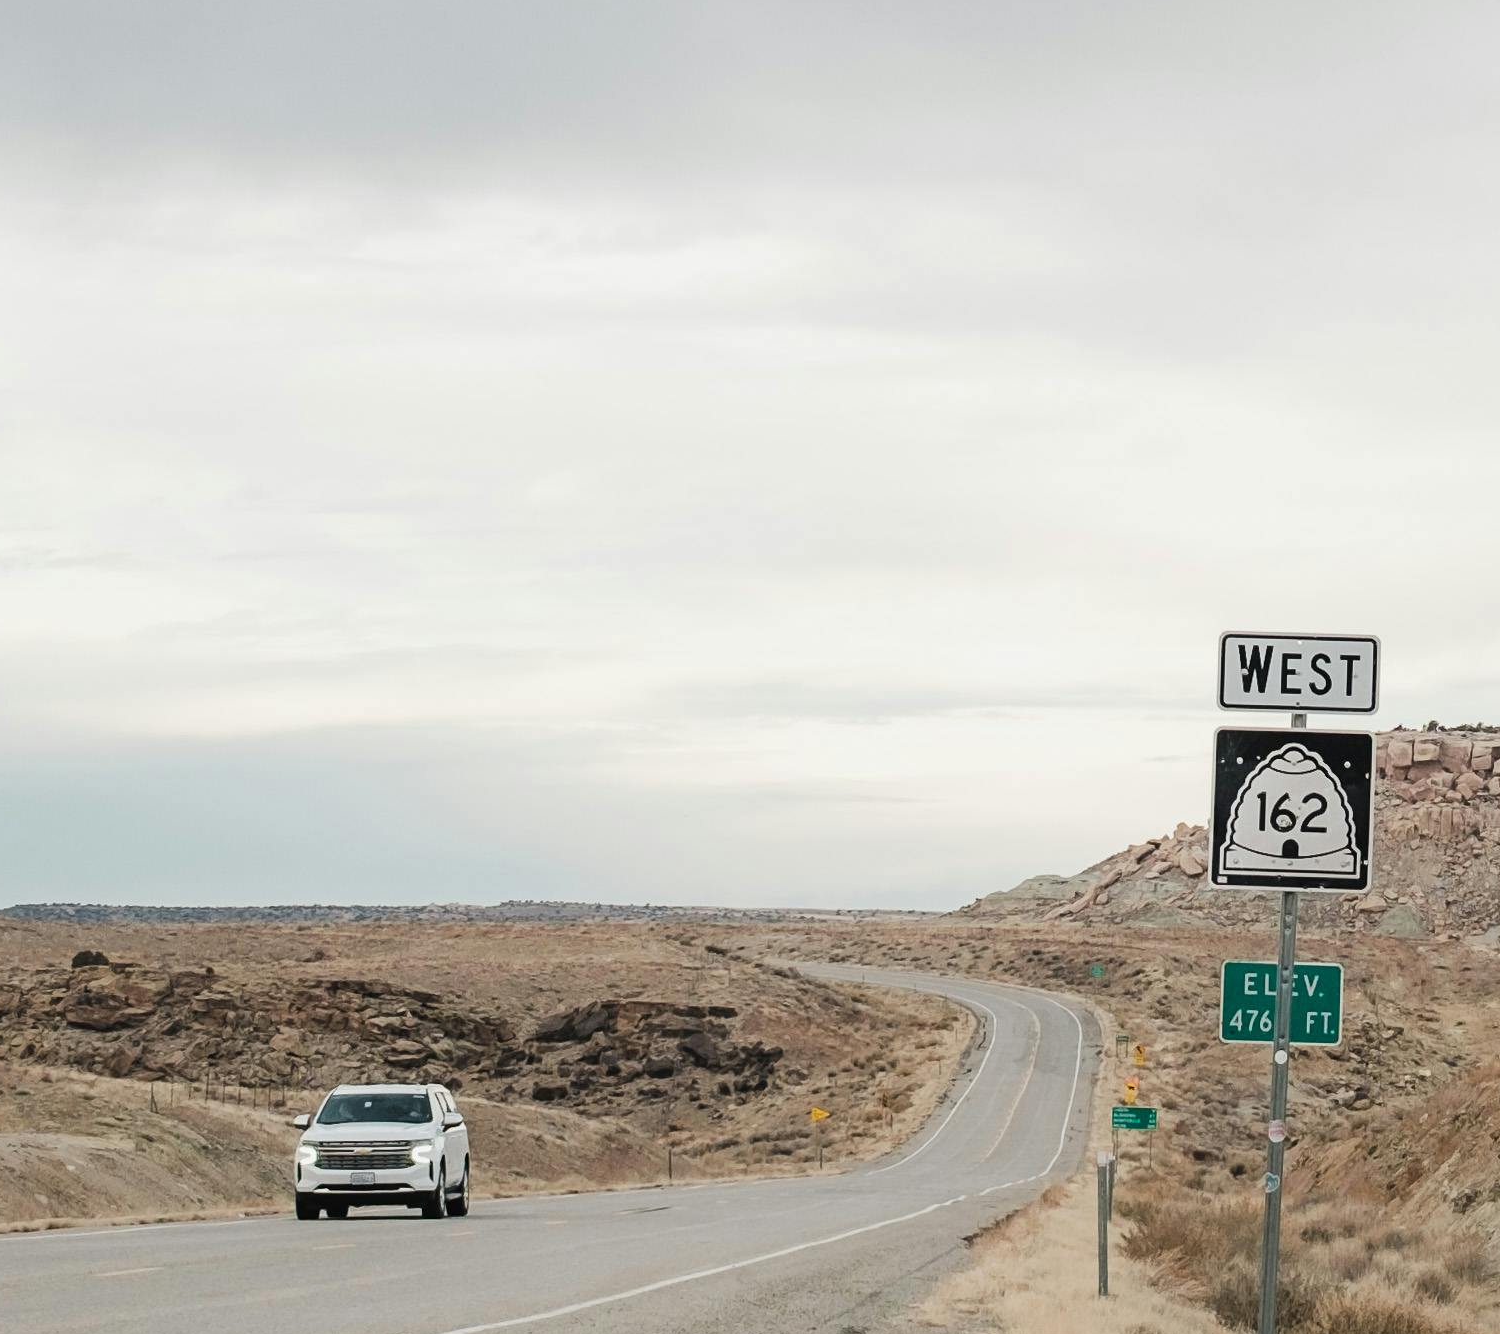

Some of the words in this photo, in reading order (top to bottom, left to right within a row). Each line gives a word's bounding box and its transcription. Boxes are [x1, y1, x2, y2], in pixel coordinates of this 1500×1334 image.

[1238, 644, 1361, 697] WEST
[1256, 791, 1328, 834] 162
[1229, 1008, 1273, 1033] 476
[1306, 1011, 1336, 1035] FT.
